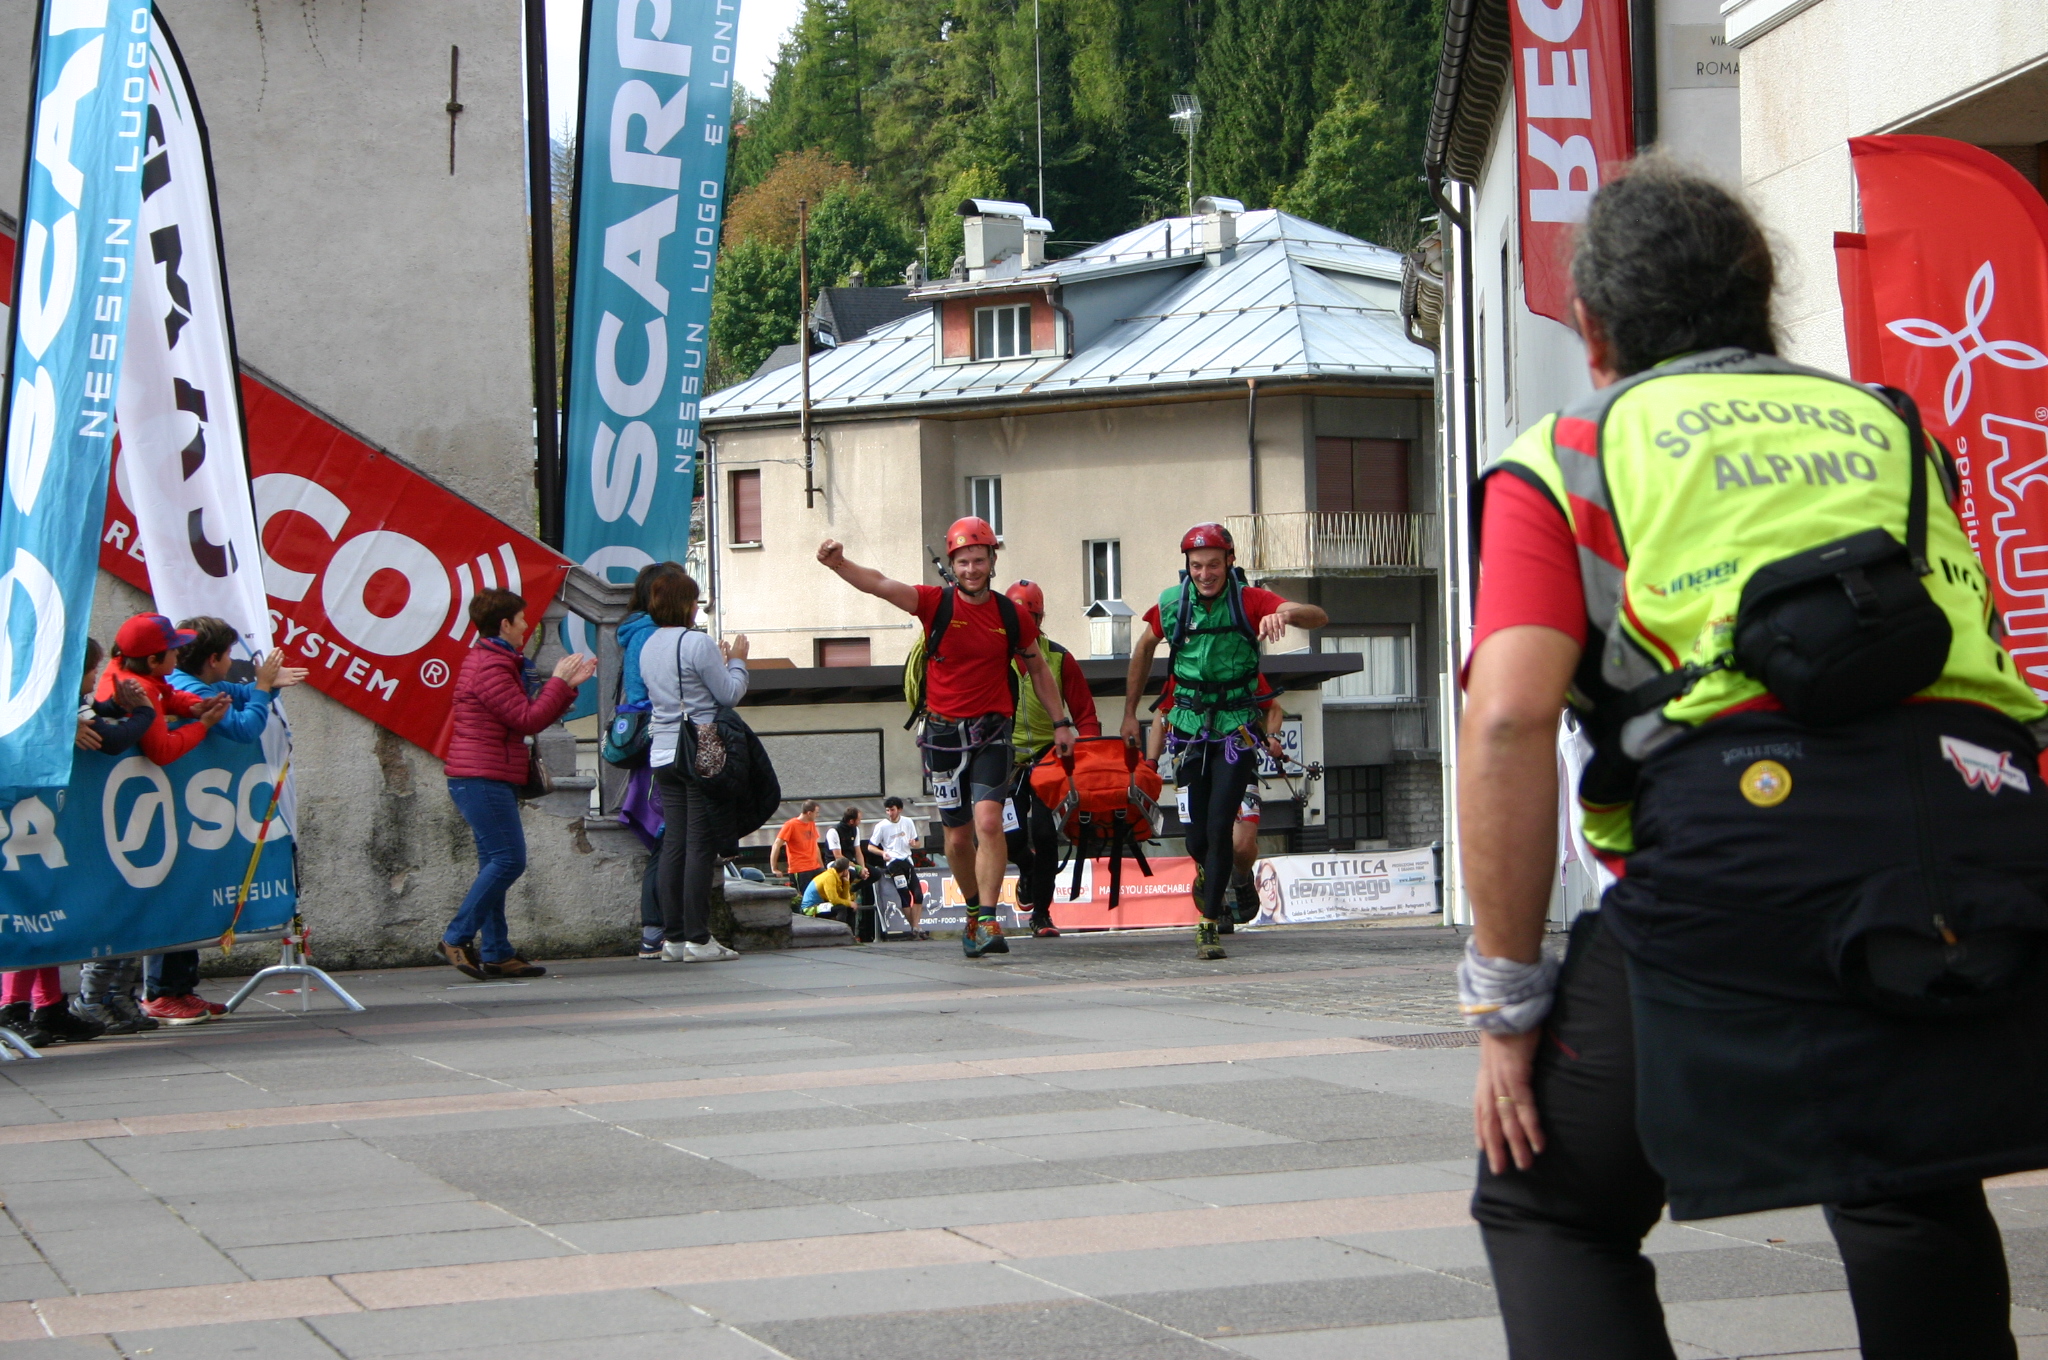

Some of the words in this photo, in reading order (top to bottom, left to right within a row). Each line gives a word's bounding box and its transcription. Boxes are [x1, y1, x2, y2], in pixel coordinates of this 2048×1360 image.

[1710, 35, 1727, 46] VIA
[1696, 61, 1740, 75] ROMA
[80, 218, 132, 438] NESSUN
[115, 7, 148, 172] LUOGO
[674, 323, 704, 474] NESSUN
[691, 179, 718, 293] LUOGO
[1655, 400, 1891, 459] SOCCORSO
[1714, 450, 1878, 491] ALPINO
[268, 608, 399, 701] SYSTEM
[1311, 859, 1389, 877] OTTICA
[1056, 886, 1085, 896] RECO
[1125, 884, 1142, 895] YOU
[1144, 883, 1191, 895] SEARCHABLE
[1289, 878, 1391, 900] demenego
[941, 917, 957, 925] FOOD
